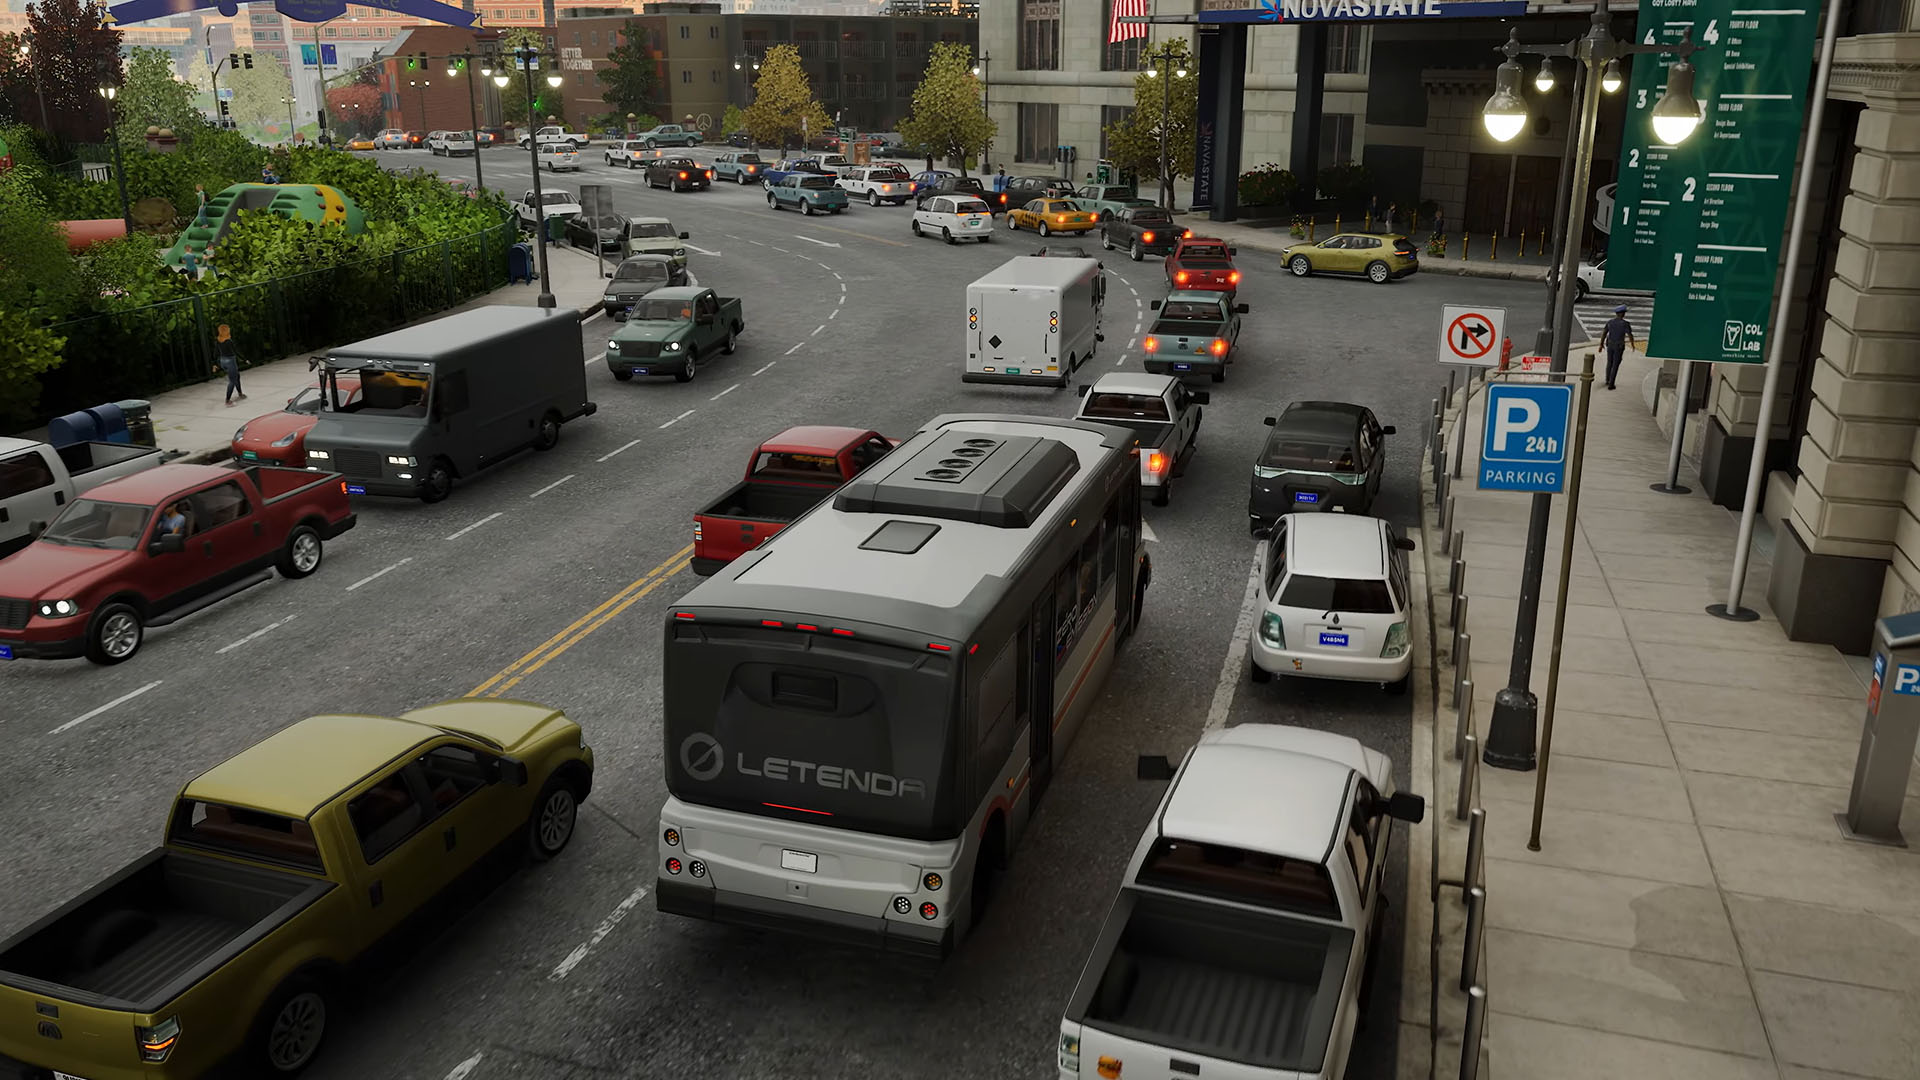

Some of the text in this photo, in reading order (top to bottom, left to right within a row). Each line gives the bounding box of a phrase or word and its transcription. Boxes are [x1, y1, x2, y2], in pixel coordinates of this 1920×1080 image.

[1283, 0, 1442, 19] NOVASTATE
[1703, 19, 1720, 45] 4
[1729, 20, 1759, 29] FOURTH FLOOR
[561, 48, 583, 58] BETTER
[562, 59, 593, 70] TOGETHER
[1636, 90, 1648, 109] 3
[1730, 103, 1743, 112] FLOOR
[1628, 149, 1640, 168] 2
[1682, 177, 1696, 202] 2
[1721, 183, 1734, 192] FLOOR
[1622, 207, 1630, 225] 1
[1674, 253, 1683, 277] 1
[1710, 255, 1723, 264] FLOOR
[1745, 324, 1763, 336] COL
[1743, 341, 1761, 351] LAB
[1493, 397, 1541, 452] P
[1525, 436, 1558, 453] 24h
[1485, 469, 1556, 485] PARKING
[1895, 667, 1920, 691] P
[736, 752, 927, 800] LETENDA
